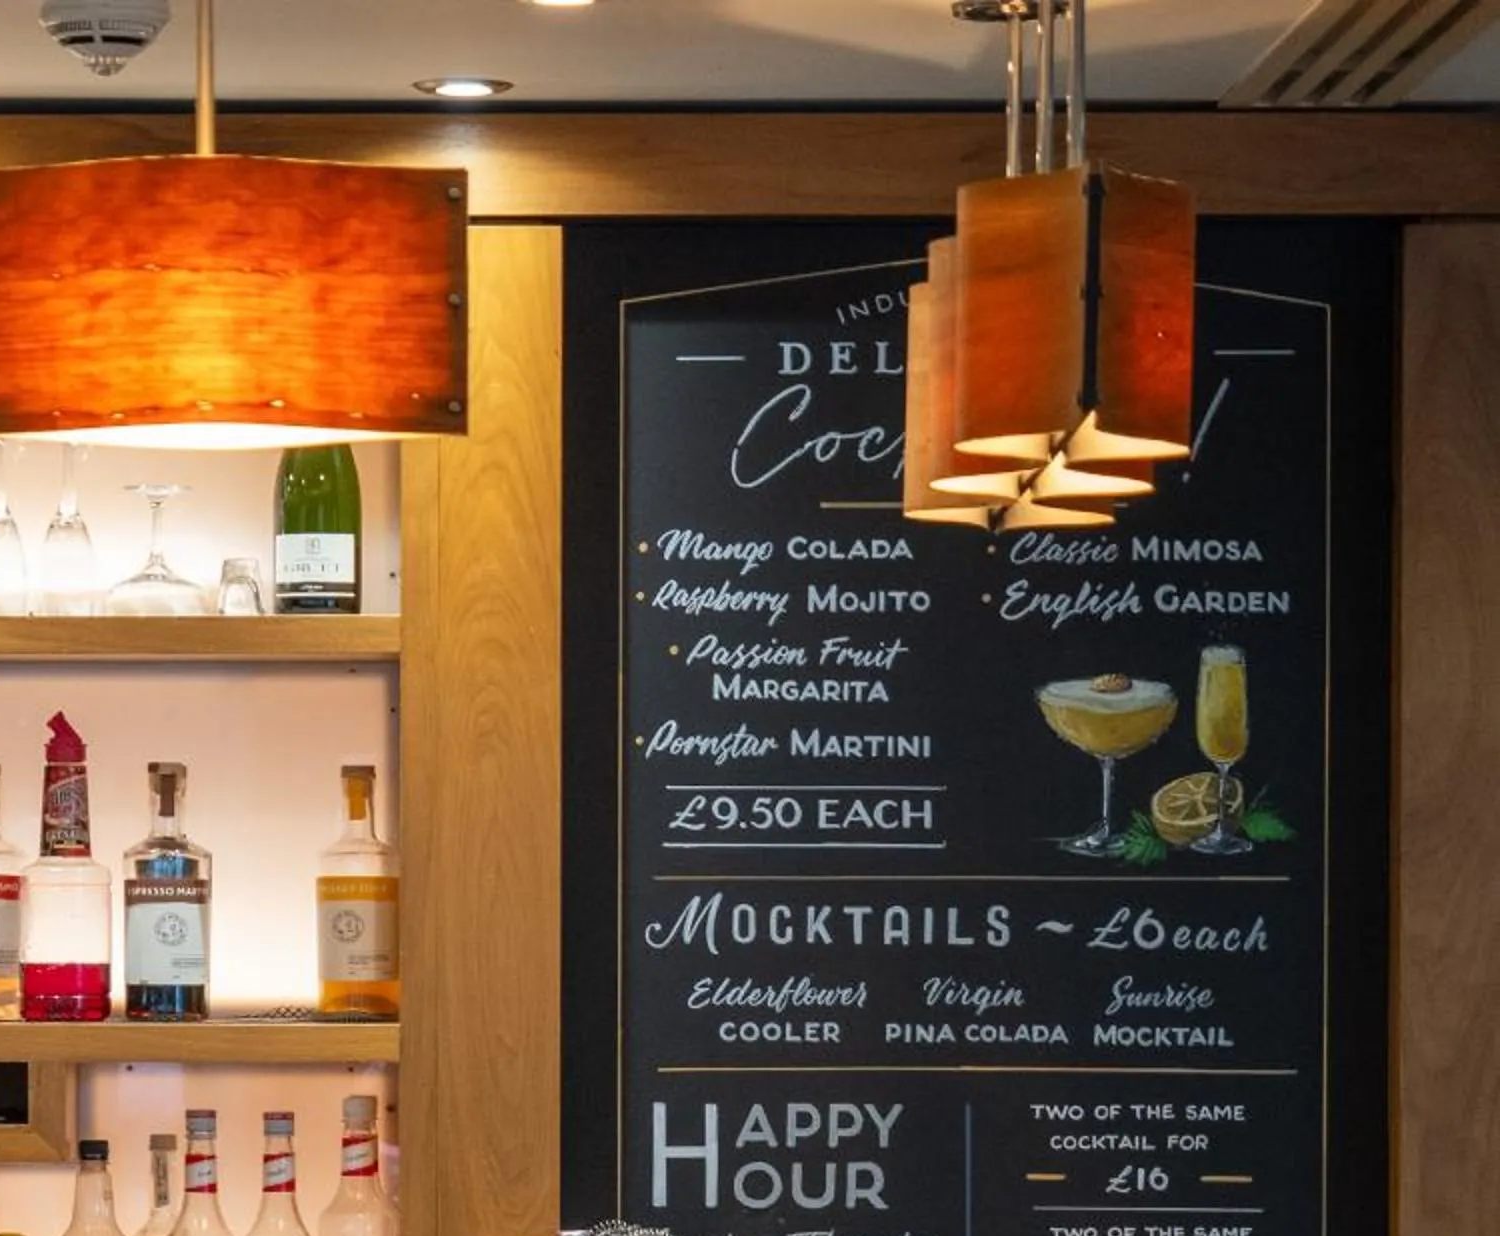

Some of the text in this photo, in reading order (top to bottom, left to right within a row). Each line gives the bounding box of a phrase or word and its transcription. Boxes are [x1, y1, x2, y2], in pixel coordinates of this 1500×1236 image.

[657, 528, 913, 575] Mango COLADA
[1010, 532, 1263, 565] Classic MIMOSA
[652, 579, 931, 626] Raspberry MOJITO
[1000, 579, 1290, 629] English GARDEN
[686, 634, 909, 670] Passion Fruit
[712, 674, 890, 702] MARGARITA
[646, 720, 931, 766] Pornstar MARTINI
[668, 795, 933, 831] £9.50 EACH
[645, 892, 1011, 954] MOCKTAILS
[1086, 907, 1165, 949] £6
[1173, 916, 1268, 950] each
[687, 976, 867, 1013] Elderflower
[924, 976, 1025, 1015] Virgin
[1105, 975, 1215, 1015] Sunrise
[719, 1021, 841, 1042] COOLER
[885, 1023, 1069, 1044] PINA COLADA
[1093, 1024, 1234, 1047] MOCKTAIL
[1030, 1104, 1245, 1121] TWO OF THE SAME
[1050, 1134, 1209, 1151] COCKTAIL FOR
[1105, 1165, 1169, 1193] £16
